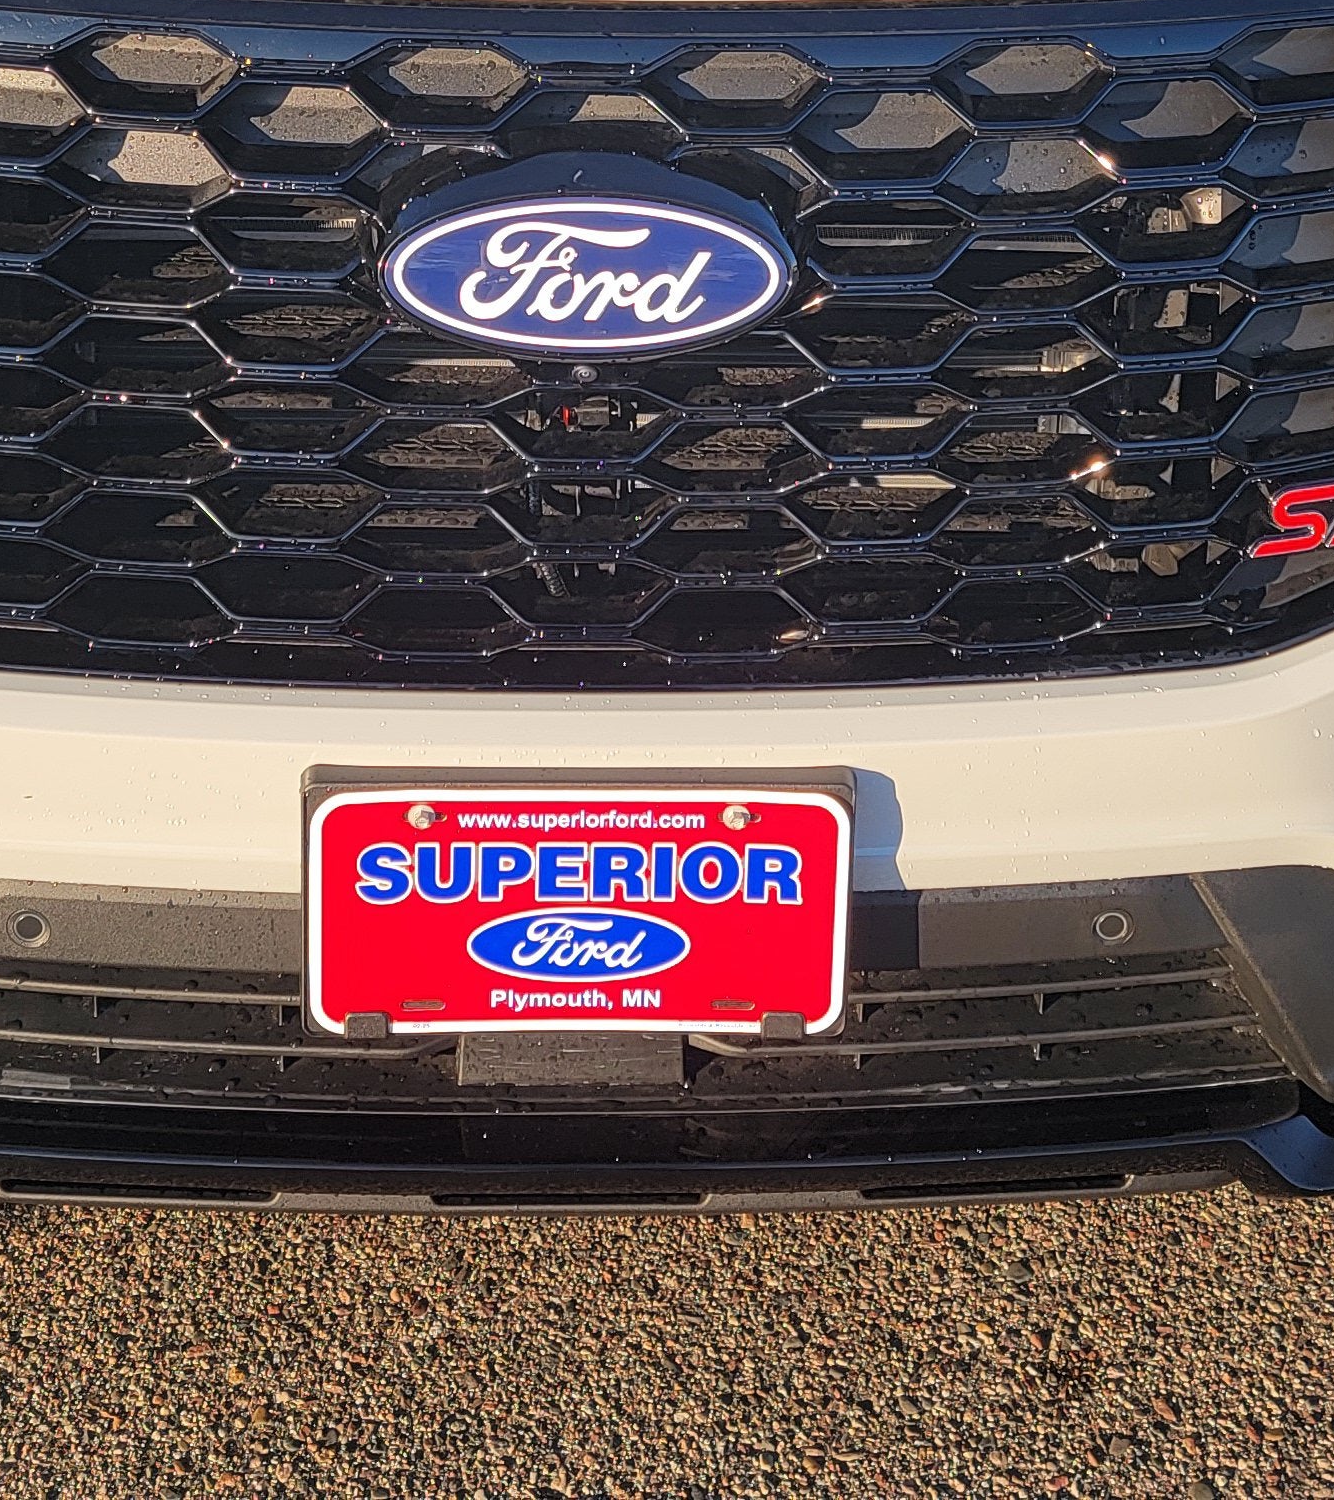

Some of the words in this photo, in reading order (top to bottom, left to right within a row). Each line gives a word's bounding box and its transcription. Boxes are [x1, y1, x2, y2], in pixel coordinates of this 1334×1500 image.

[459, 221, 713, 323] Ford
[457, 810, 706, 831] www.superiorford.com
[355, 841, 804, 906] SUPERIOR
[511, 917, 645, 969] Ford
[490, 989, 614, 1013] Plymouth,
[622, 989, 662, 1009] MN
